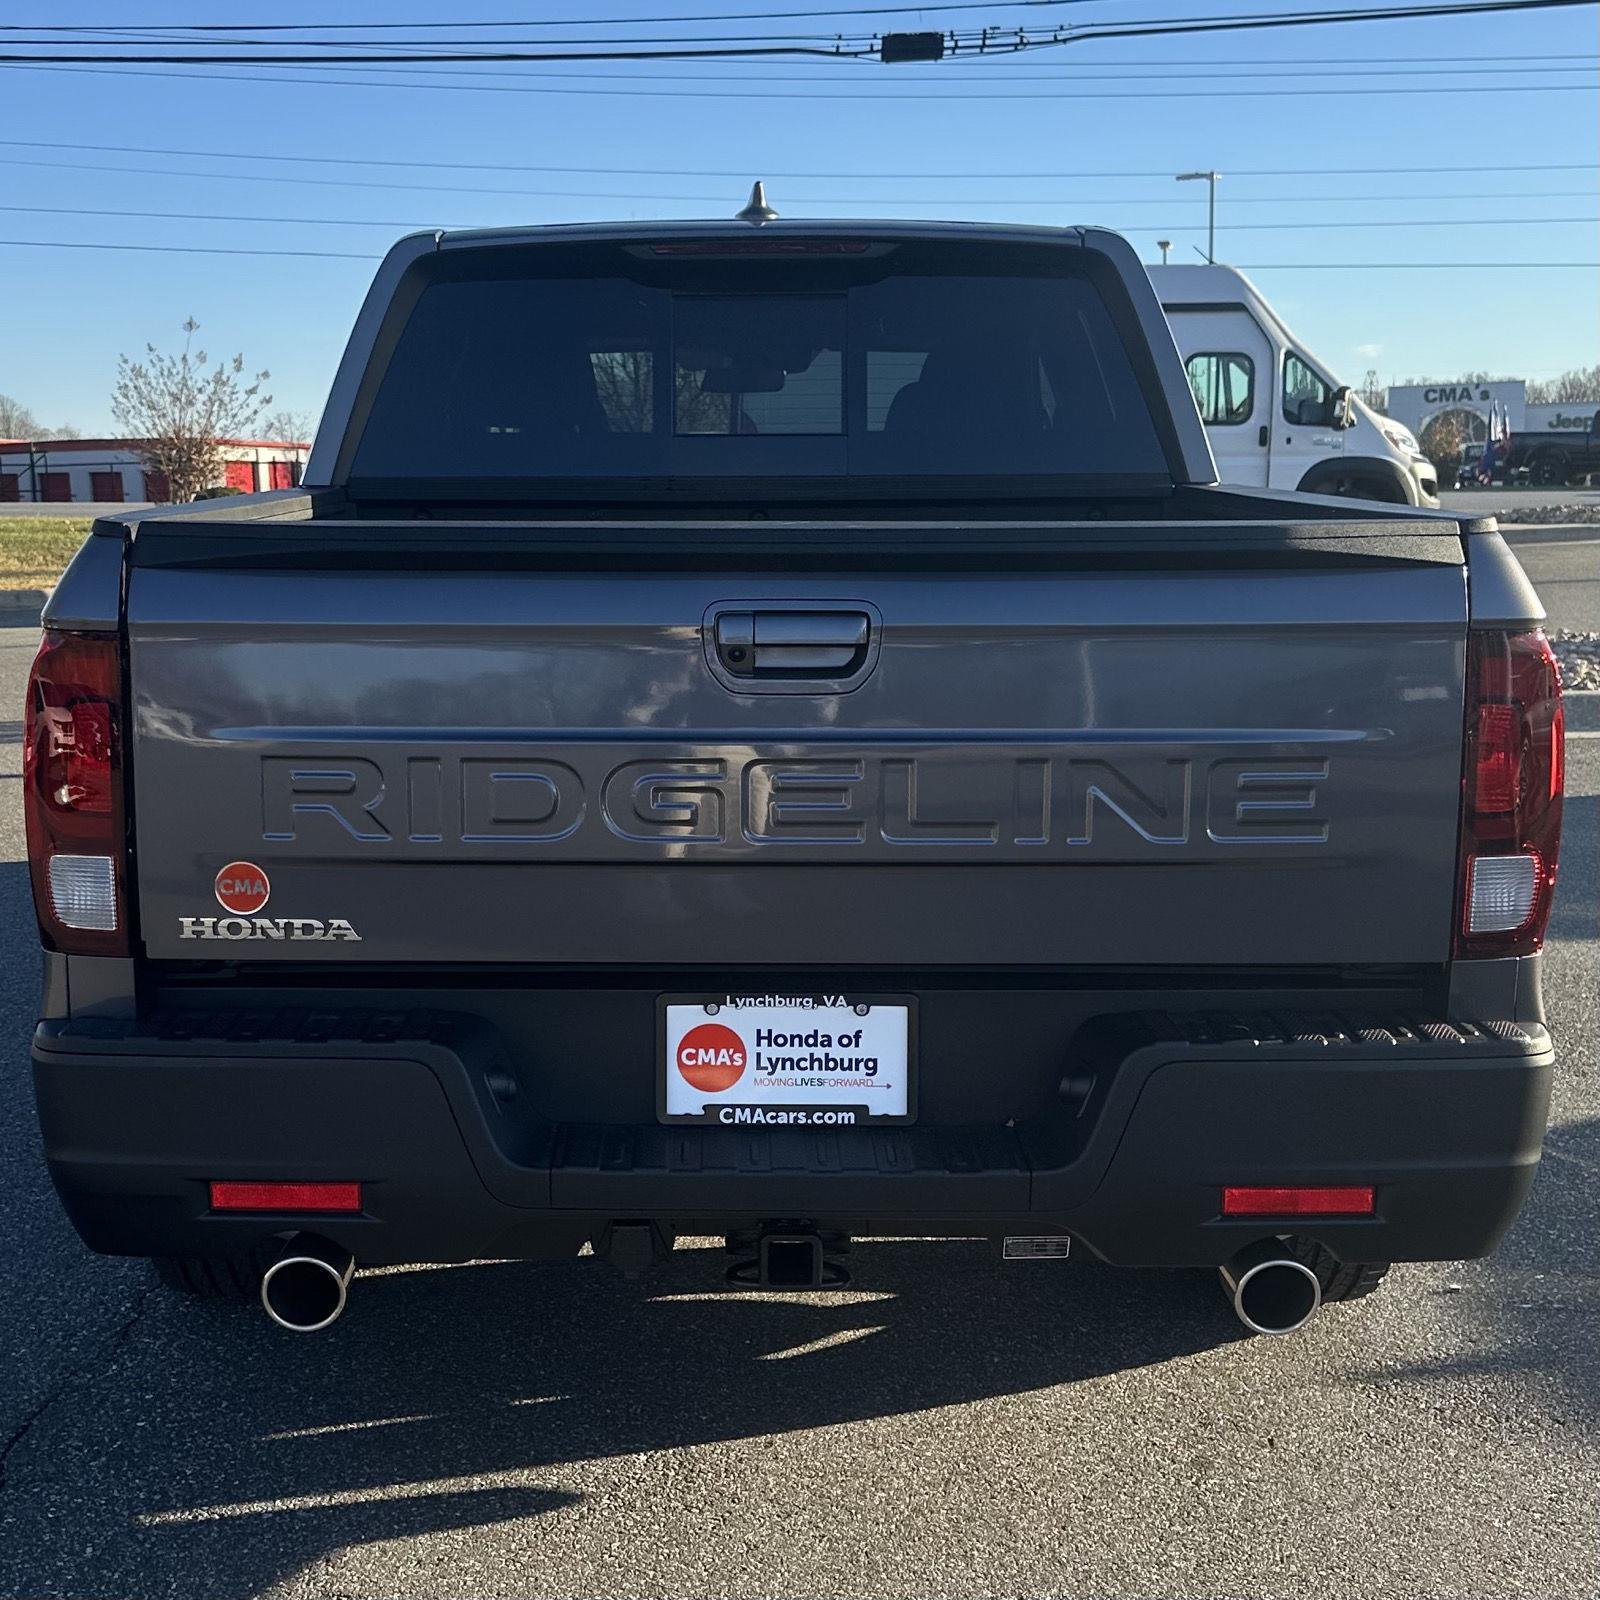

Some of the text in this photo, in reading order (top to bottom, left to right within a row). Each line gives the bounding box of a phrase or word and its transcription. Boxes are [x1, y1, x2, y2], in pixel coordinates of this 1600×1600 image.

[1424, 384, 1490, 403] CMA's
[261, 755, 1330, 845] RIDGELINE
[218, 879, 267, 896] CMA
[178, 917, 363, 941] HONDA
[726, 995, 848, 1009] Lynchburg, VA
[756, 1028, 863, 1048] Honda of
[681, 1048, 743, 1067] CMA's
[755, 1052, 878, 1077] Lynchburg
[719, 1107, 855, 1125] CMAcars.com
